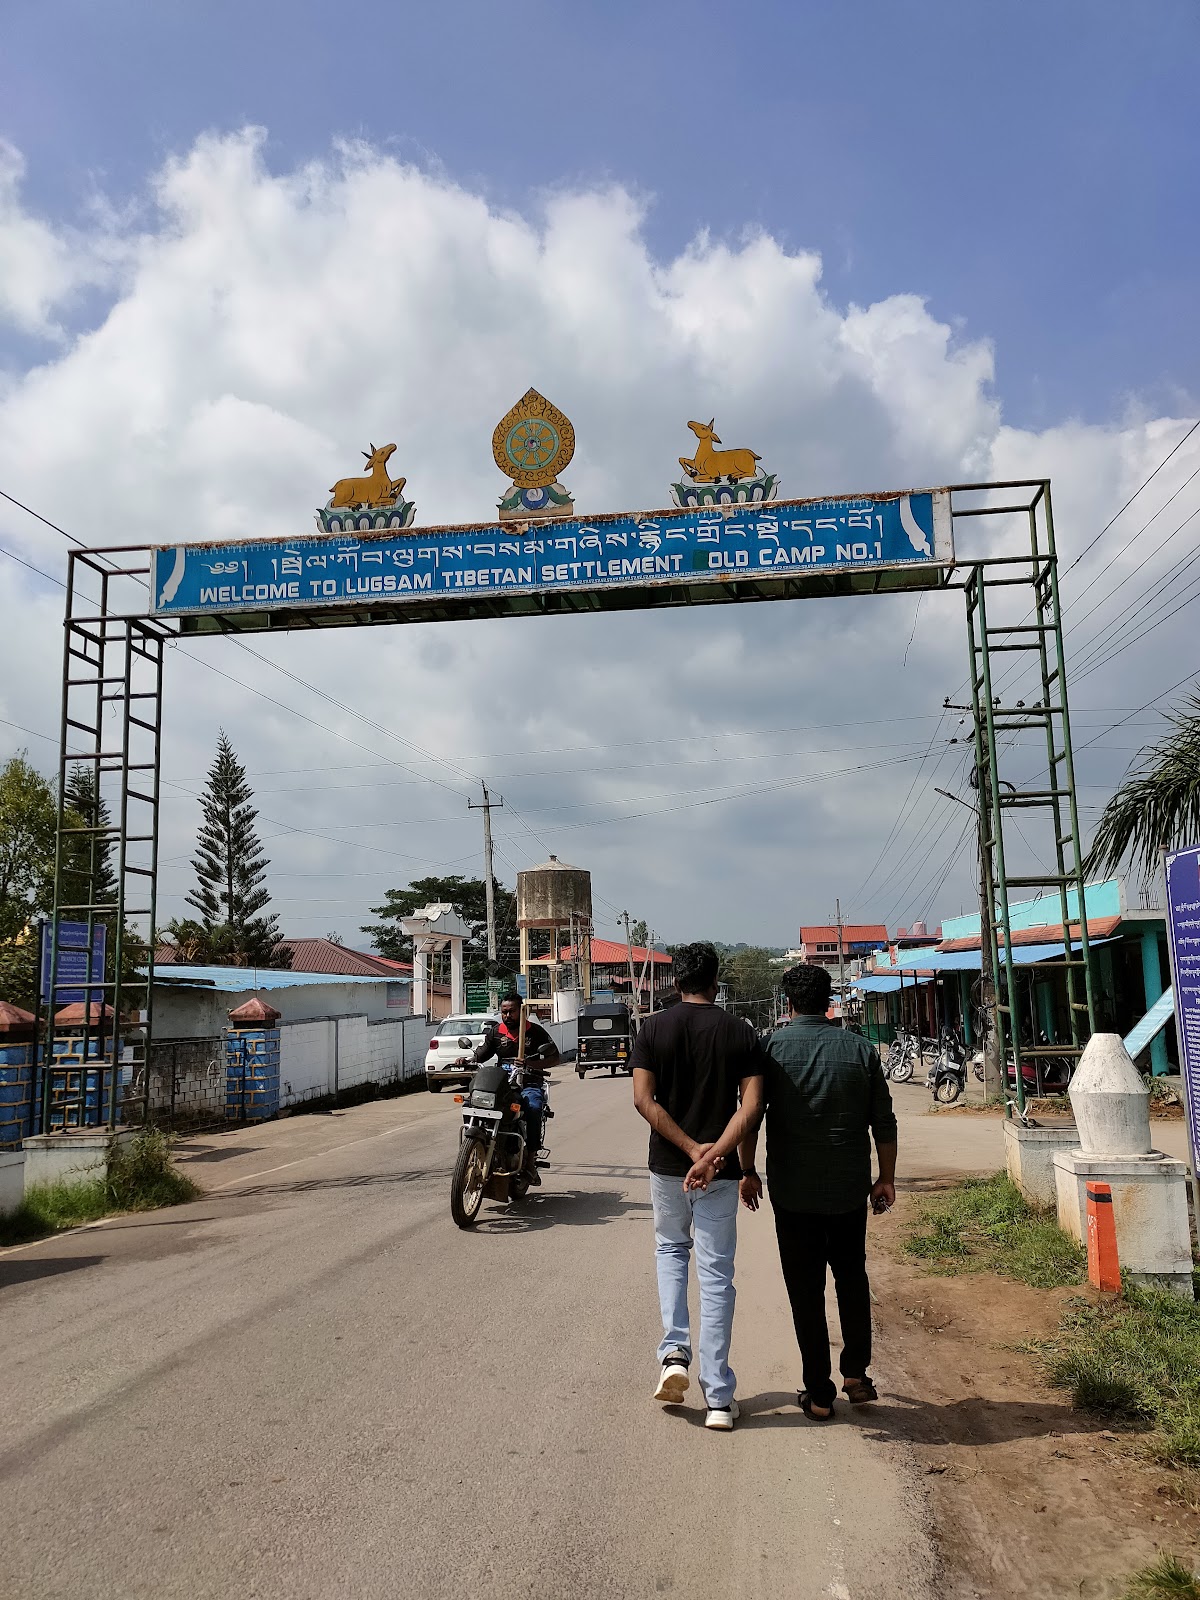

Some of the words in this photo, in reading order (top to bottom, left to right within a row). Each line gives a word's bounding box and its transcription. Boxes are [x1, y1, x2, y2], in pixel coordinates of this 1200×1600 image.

[200, 581, 300, 603] WELCOME
[310, 579, 337, 596] TO
[346, 573, 432, 593] LUGSAM
[442, 566, 532, 587] TIBETAN
[541, 554, 683, 581] SETTLEMENT
[708, 550, 749, 568] OLD
[759, 545, 825, 565] CAMP
[836, 541, 882, 560] NO.1
